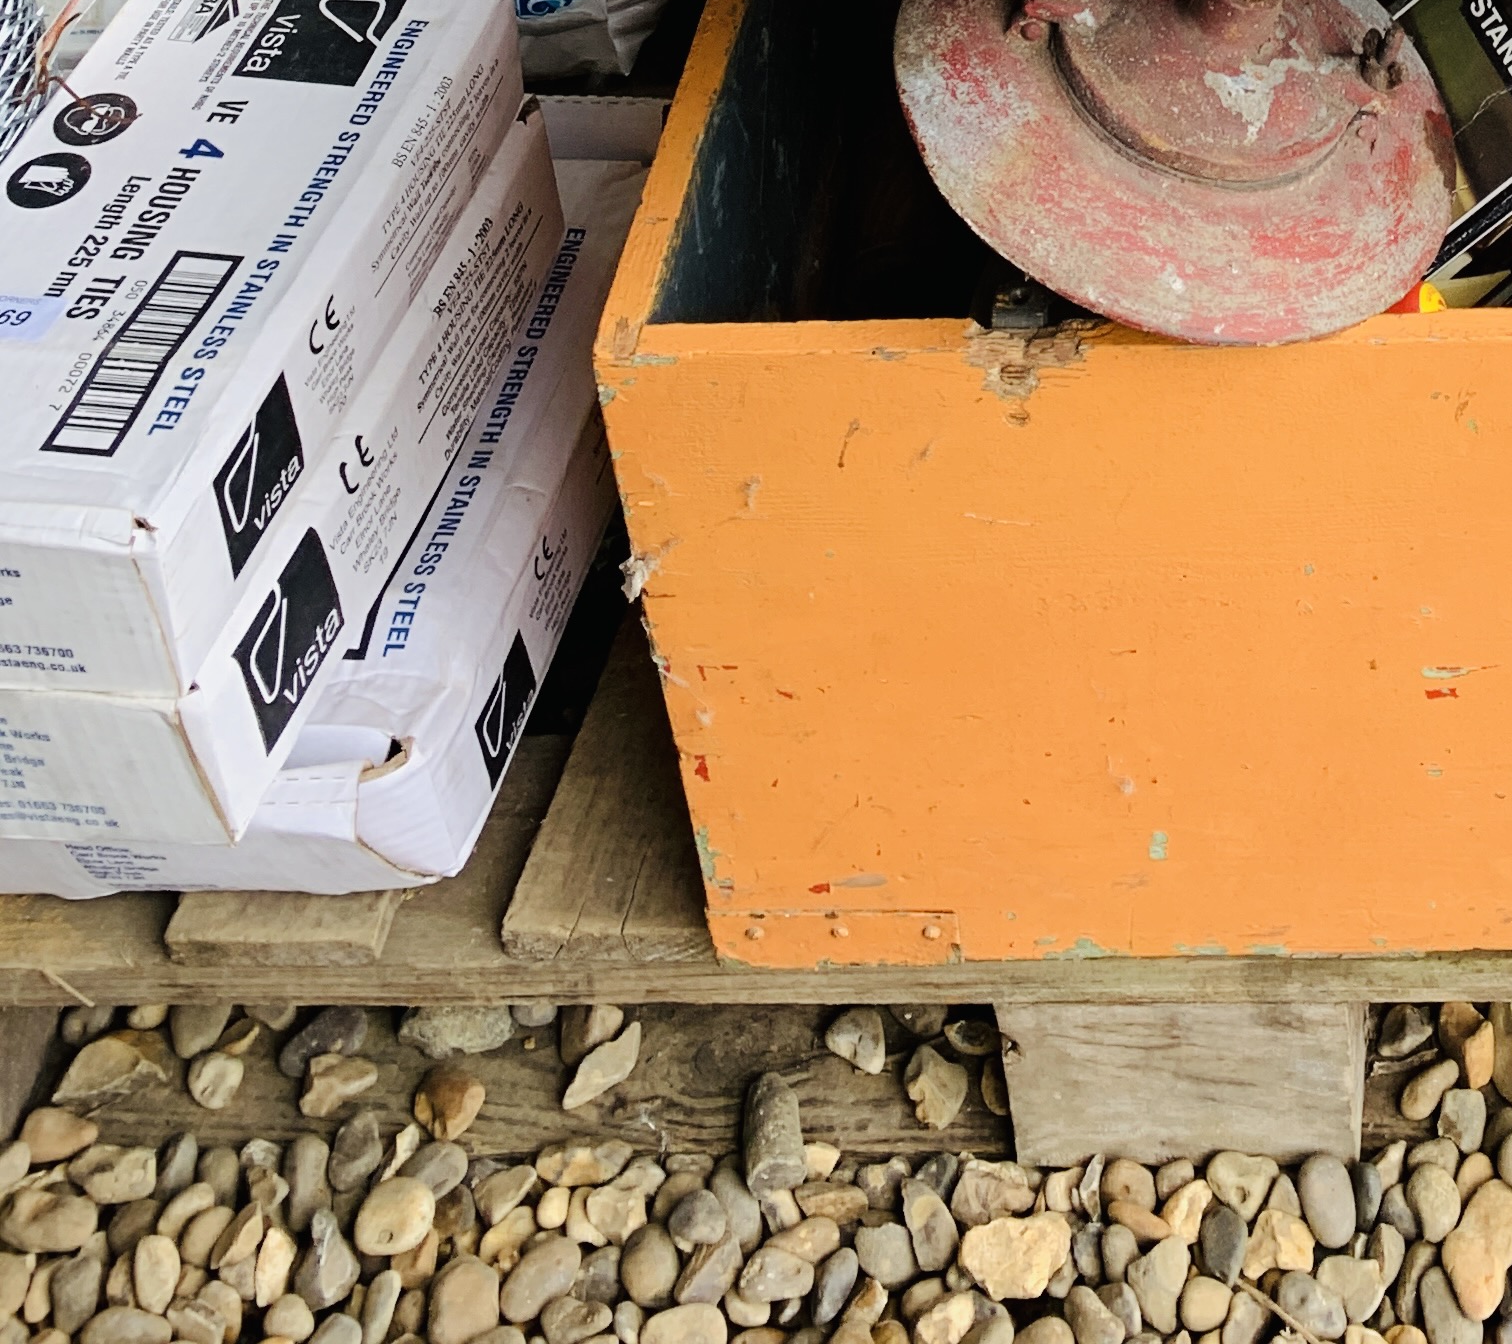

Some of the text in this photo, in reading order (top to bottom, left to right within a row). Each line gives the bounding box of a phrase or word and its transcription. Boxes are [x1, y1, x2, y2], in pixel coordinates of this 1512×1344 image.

[243, 14, 302, 73] vista
[411, 117, 429, 137] 845
[434, 75, 453, 100] 2003
[66, 100, 250, 321] VE 4 HOUSING TIES
[94, 176, 152, 231] Length
[147, 19, 430, 438] ENGINEERED STRENGTH IN STAINLESS STEEL
[475, 217, 493, 244] 2003
[67, 234, 109, 269] 225
[526, 226, 587, 341] ENGINEERED
[479, 345, 540, 444] STRENGTH
[254, 455, 302, 530] vista
[348, 450, 394, 518] Engineering
[467, 448, 495, 469] IN
[373, 484, 391, 515] Lane
[413, 475, 482, 578] STAINLESS
[340, 528, 354, 554] Carr
[382, 583, 426, 659] STEEL
[283, 607, 340, 704] vista
